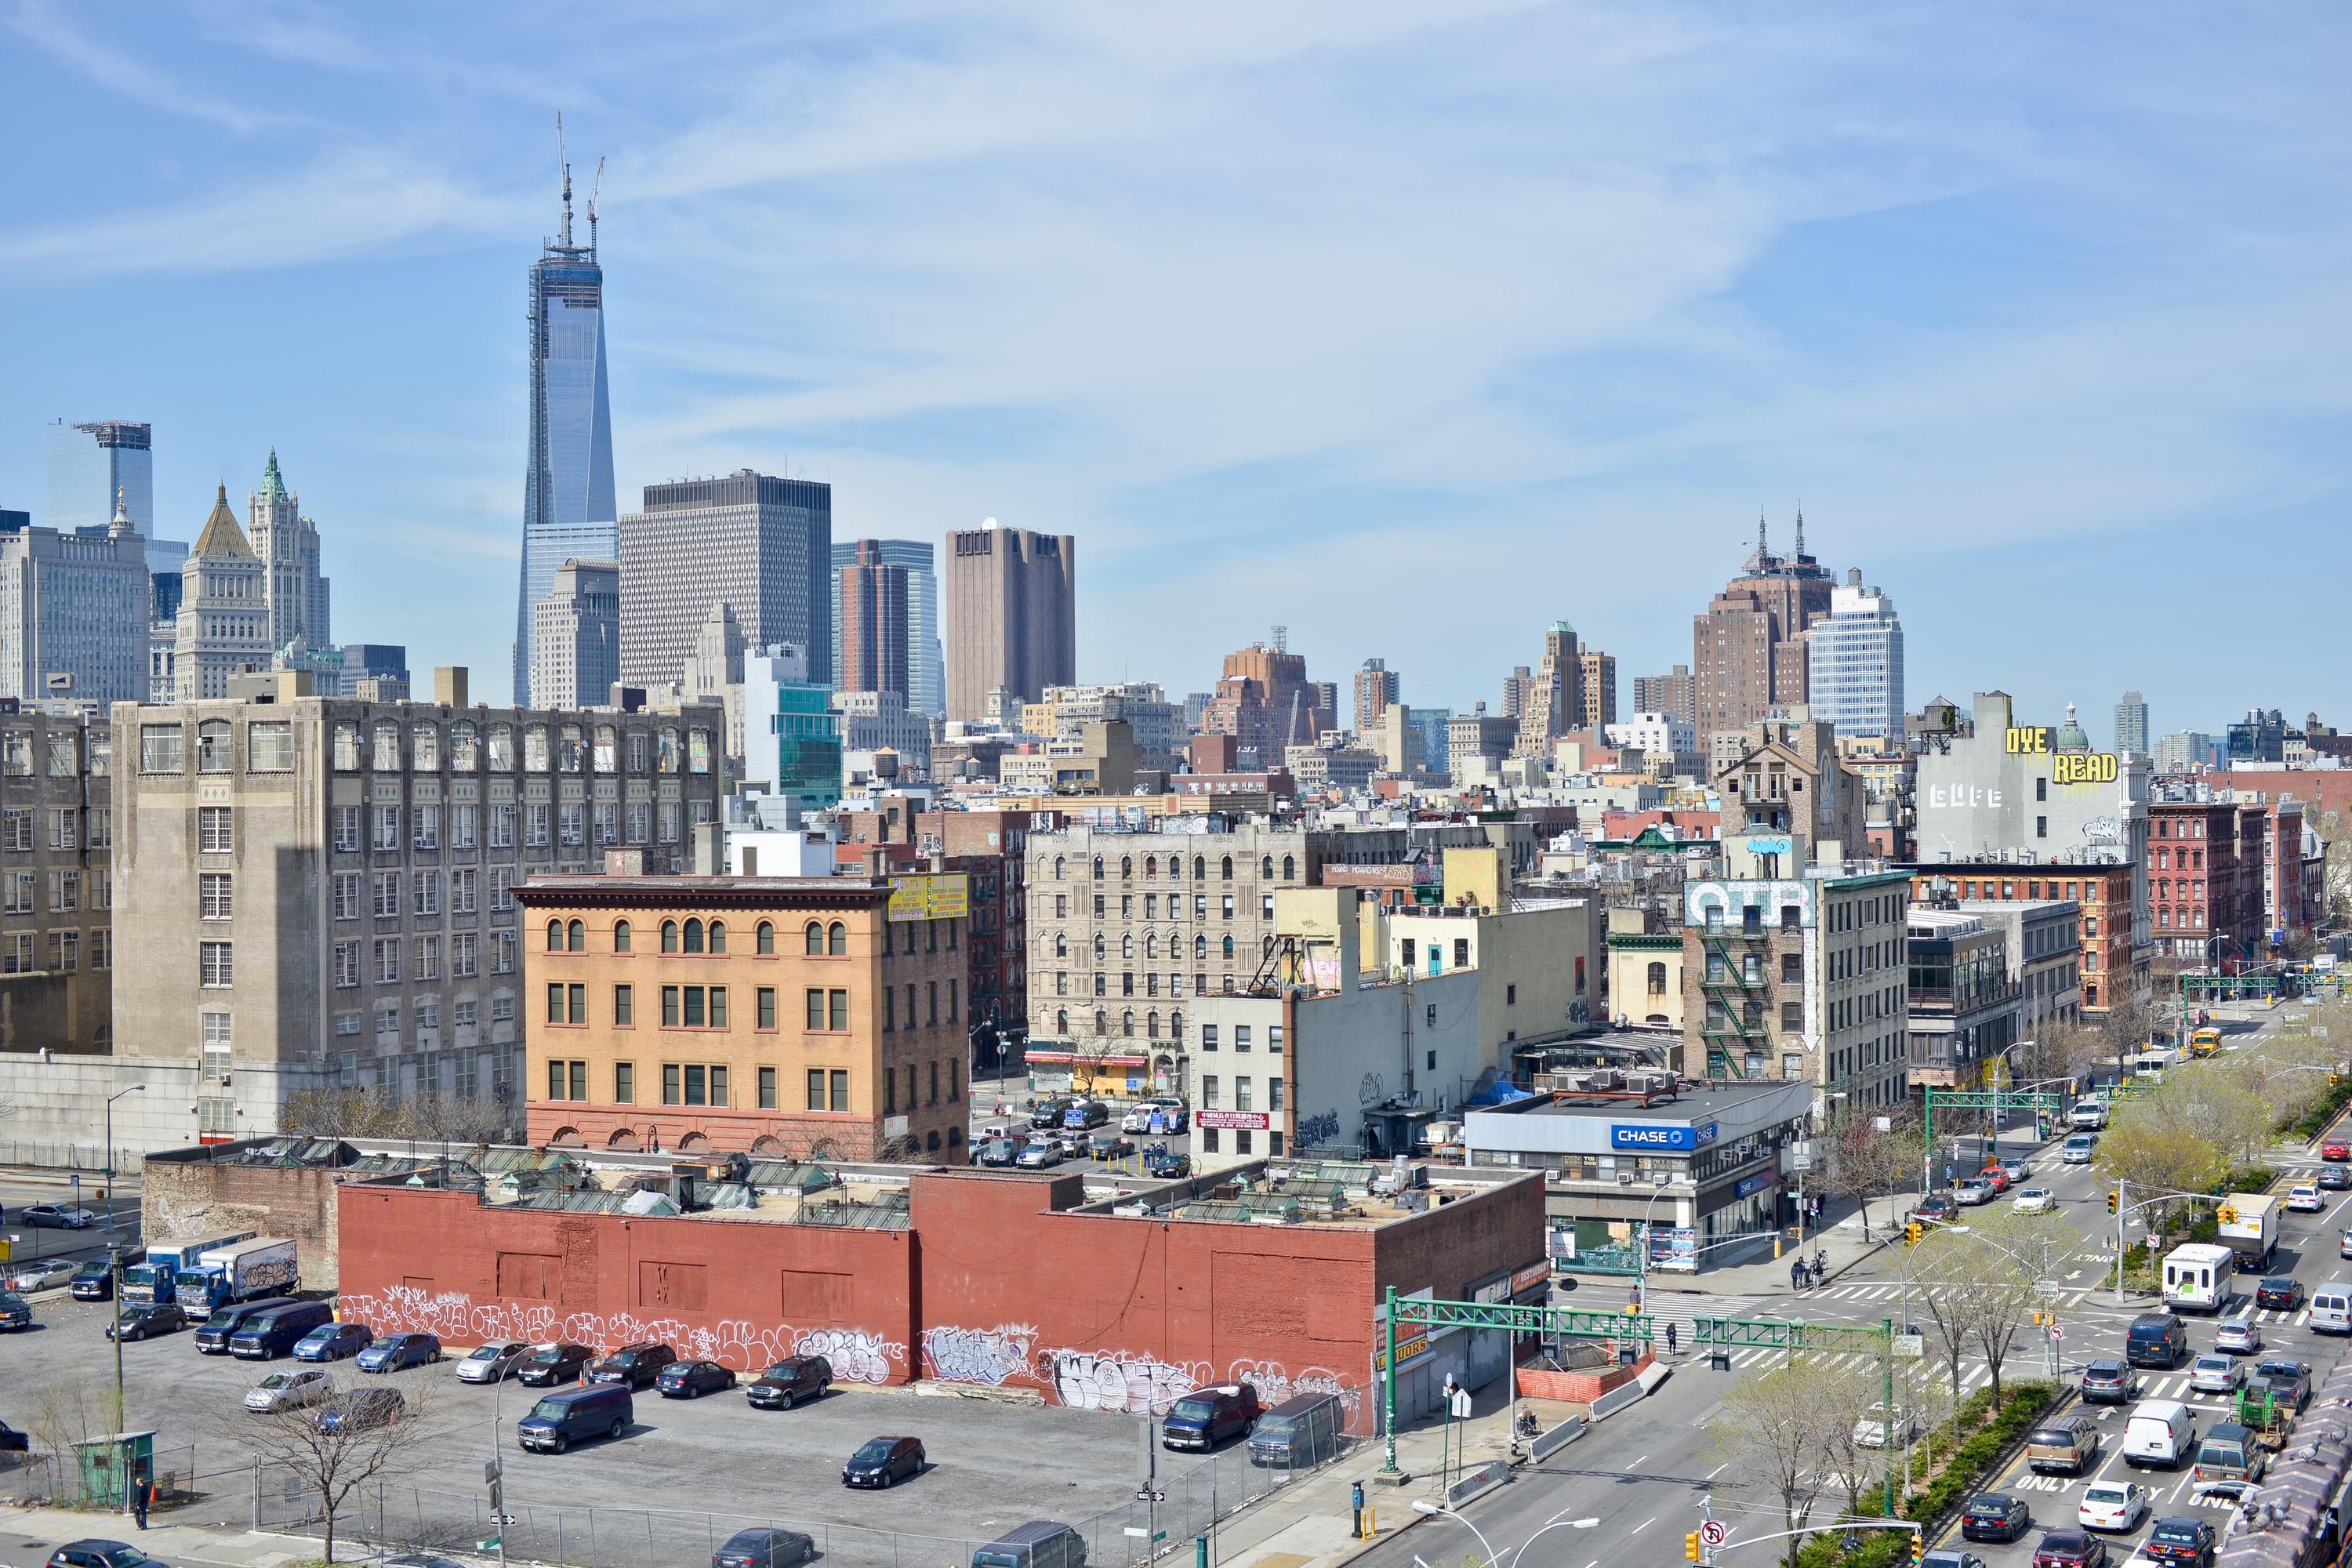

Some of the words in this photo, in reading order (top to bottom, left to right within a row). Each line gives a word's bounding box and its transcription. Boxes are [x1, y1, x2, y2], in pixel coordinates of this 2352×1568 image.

[2053, 753, 2119, 785] READ
[1617, 1130, 1668, 1143] CHASE
[1697, 1127, 1713, 1142] CHASE
[1740, 1181, 1752, 1194] CHASE
[1377, 1338, 1426, 1369] LUORS
[2015, 1475, 2078, 1493] ONLY
[2187, 1492, 2236, 1511] ONL
